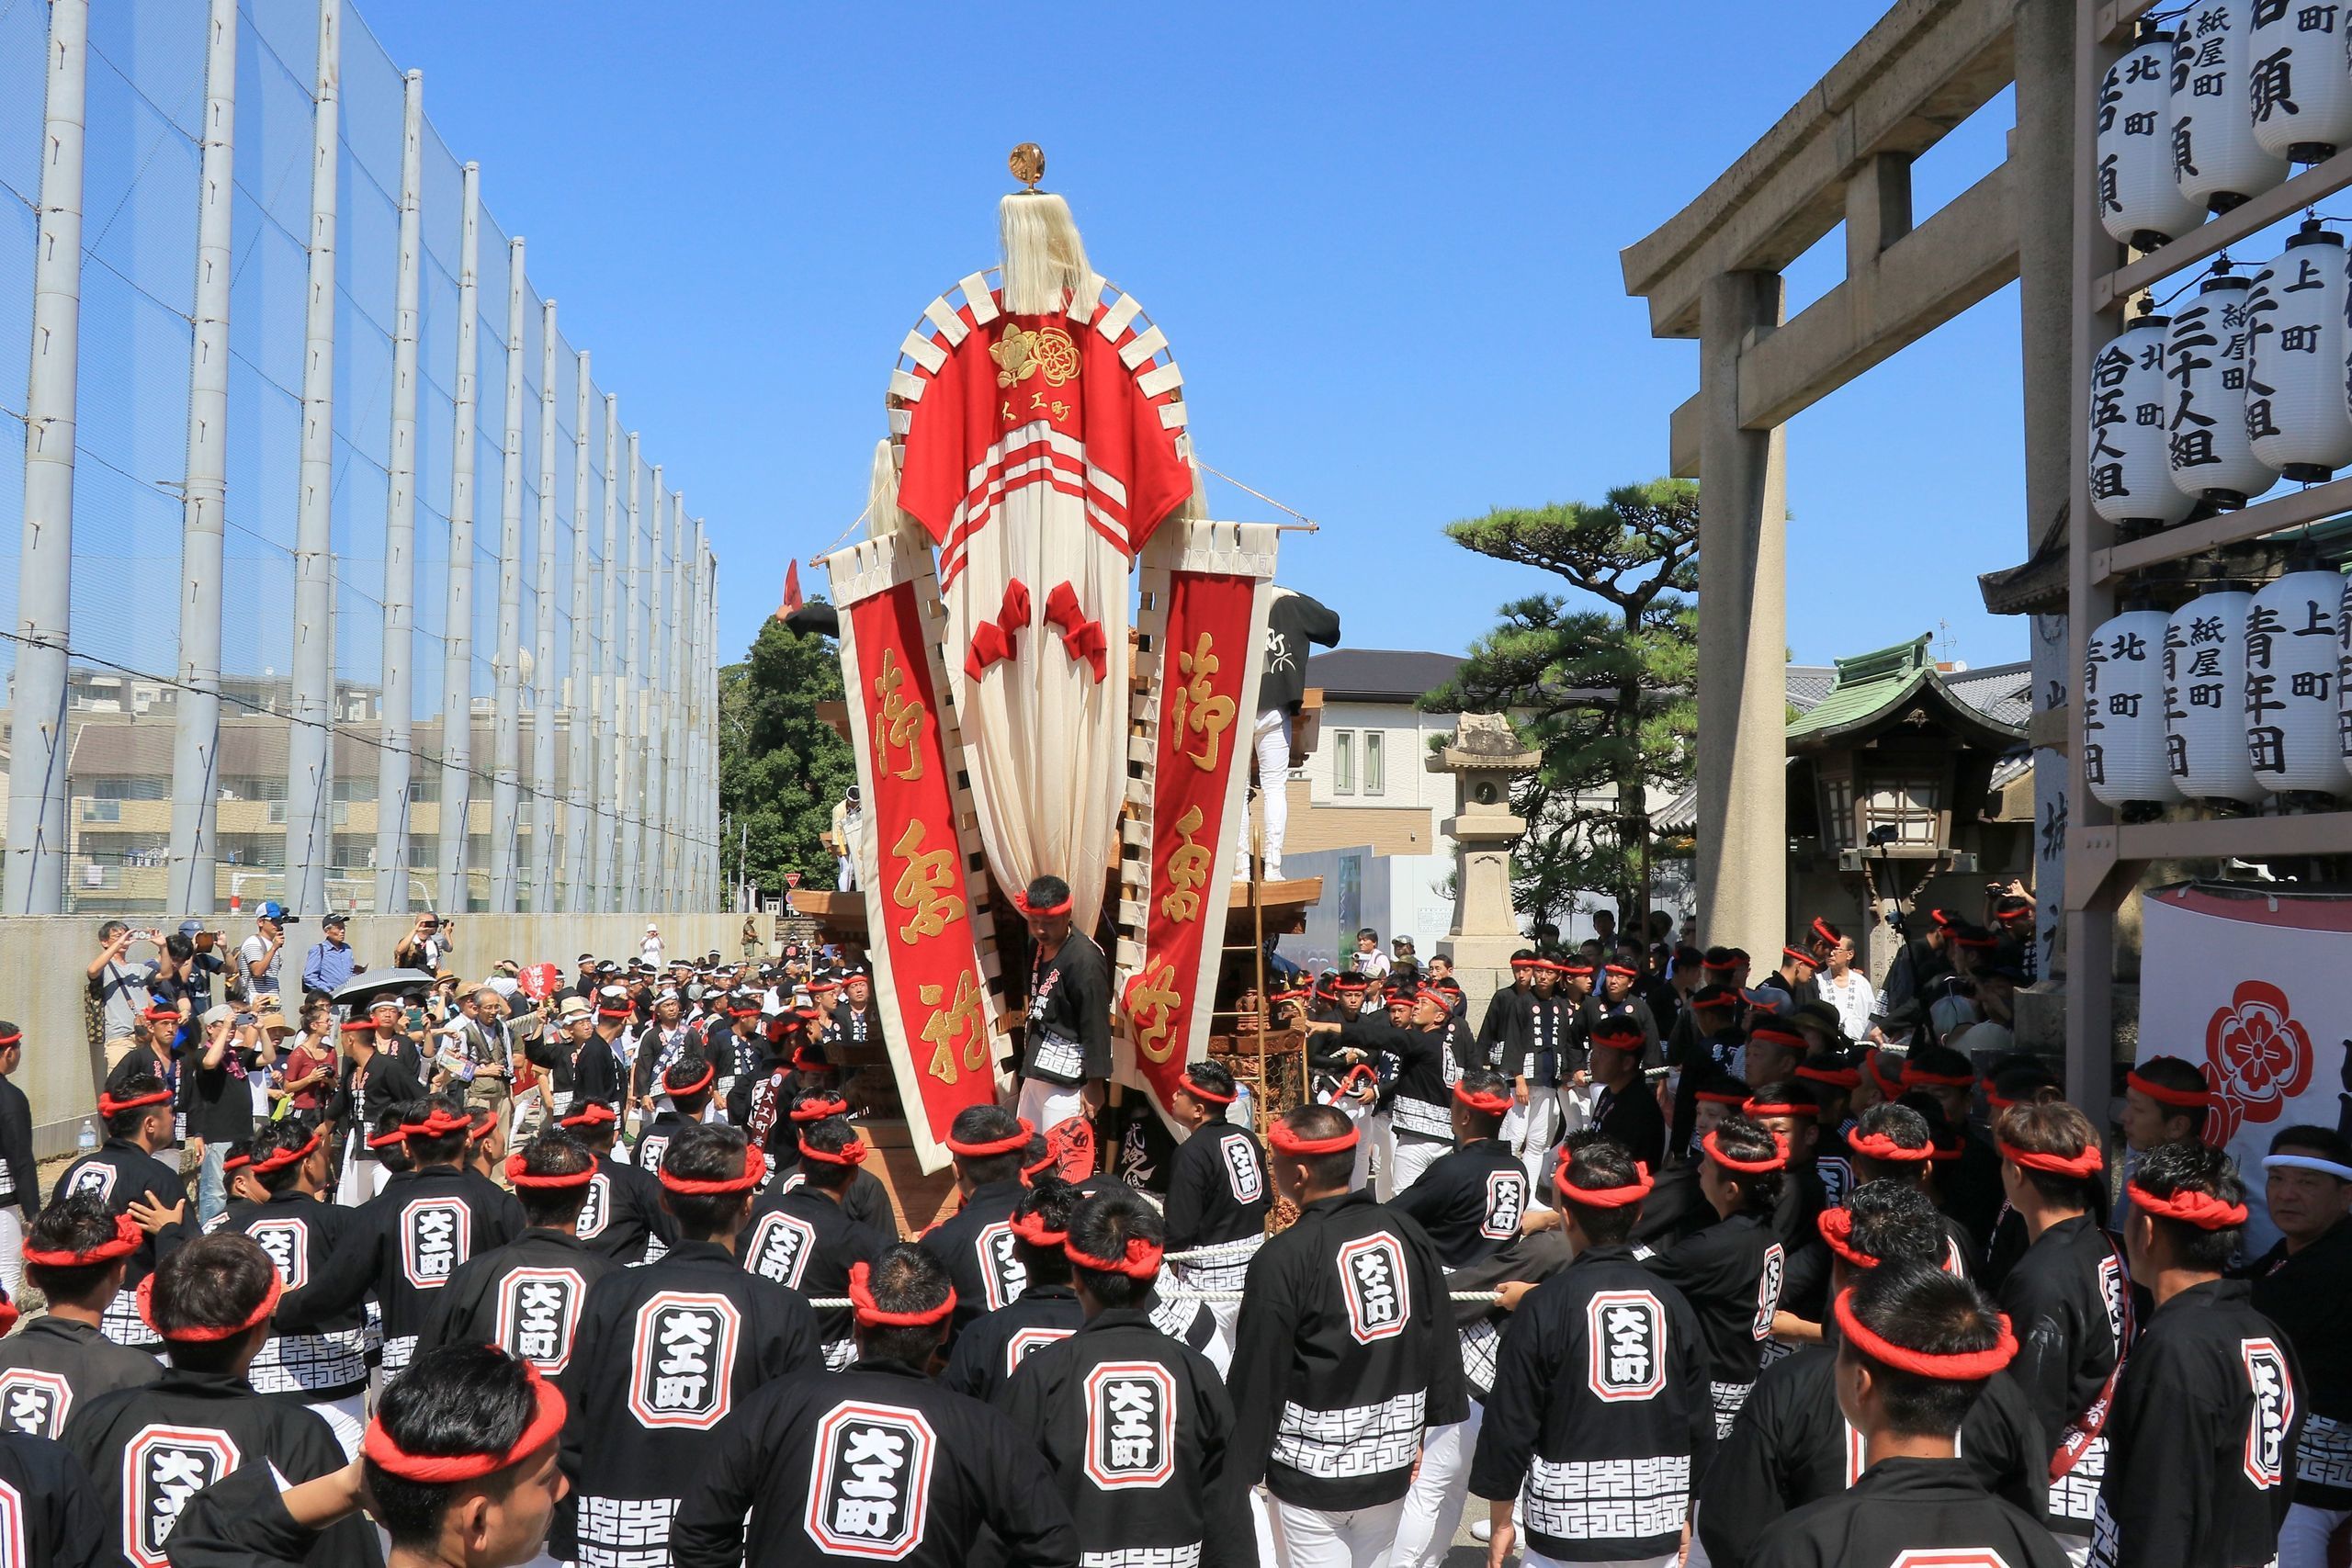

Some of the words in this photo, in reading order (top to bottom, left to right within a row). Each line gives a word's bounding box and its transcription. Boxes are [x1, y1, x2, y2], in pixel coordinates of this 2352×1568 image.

[2193, 6, 2231, 96] 紙屋町
[2124, 55, 2159, 136] 北町
[2281, 259, 2324, 353] 上町
[2167, 307, 2222, 471] 三十人組
[2245, 269, 2280, 444] 三十人組
[2089, 345, 2134, 502] 拾伍人組
[2109, 632, 2146, 717] 北町
[2188, 615, 2227, 708] 紙屋町
[2244, 605, 2286, 773] 青年団
[2292, 600, 2335, 701] 上町
[2085, 638, 2109, 784] 青年団
[2163, 623, 2188, 777] 青年団
[530, 966, 545, 998] 世話人
[1847, 979, 1856, 1009] 岸城神社
[645, 1145, 661, 1176] 大工
[1230, 1145, 1255, 1193] 大工町
[418, 1210, 454, 1274] 大工町
[1492, 1181, 1519, 1231] 大工町
[758, 1225, 798, 1283] 大工町
[1353, 1252, 1395, 1325] 大工町
[1760, 1258, 1782, 1326] 大工町
[519, 1282, 561, 1359] 大工町
[654, 1311, 713, 1409] 大工町
[1606, 1306, 1651, 1383] 大工町
[1108, 1381, 1155, 1467] 大工町
[834, 1427, 905, 1538] 大工町
